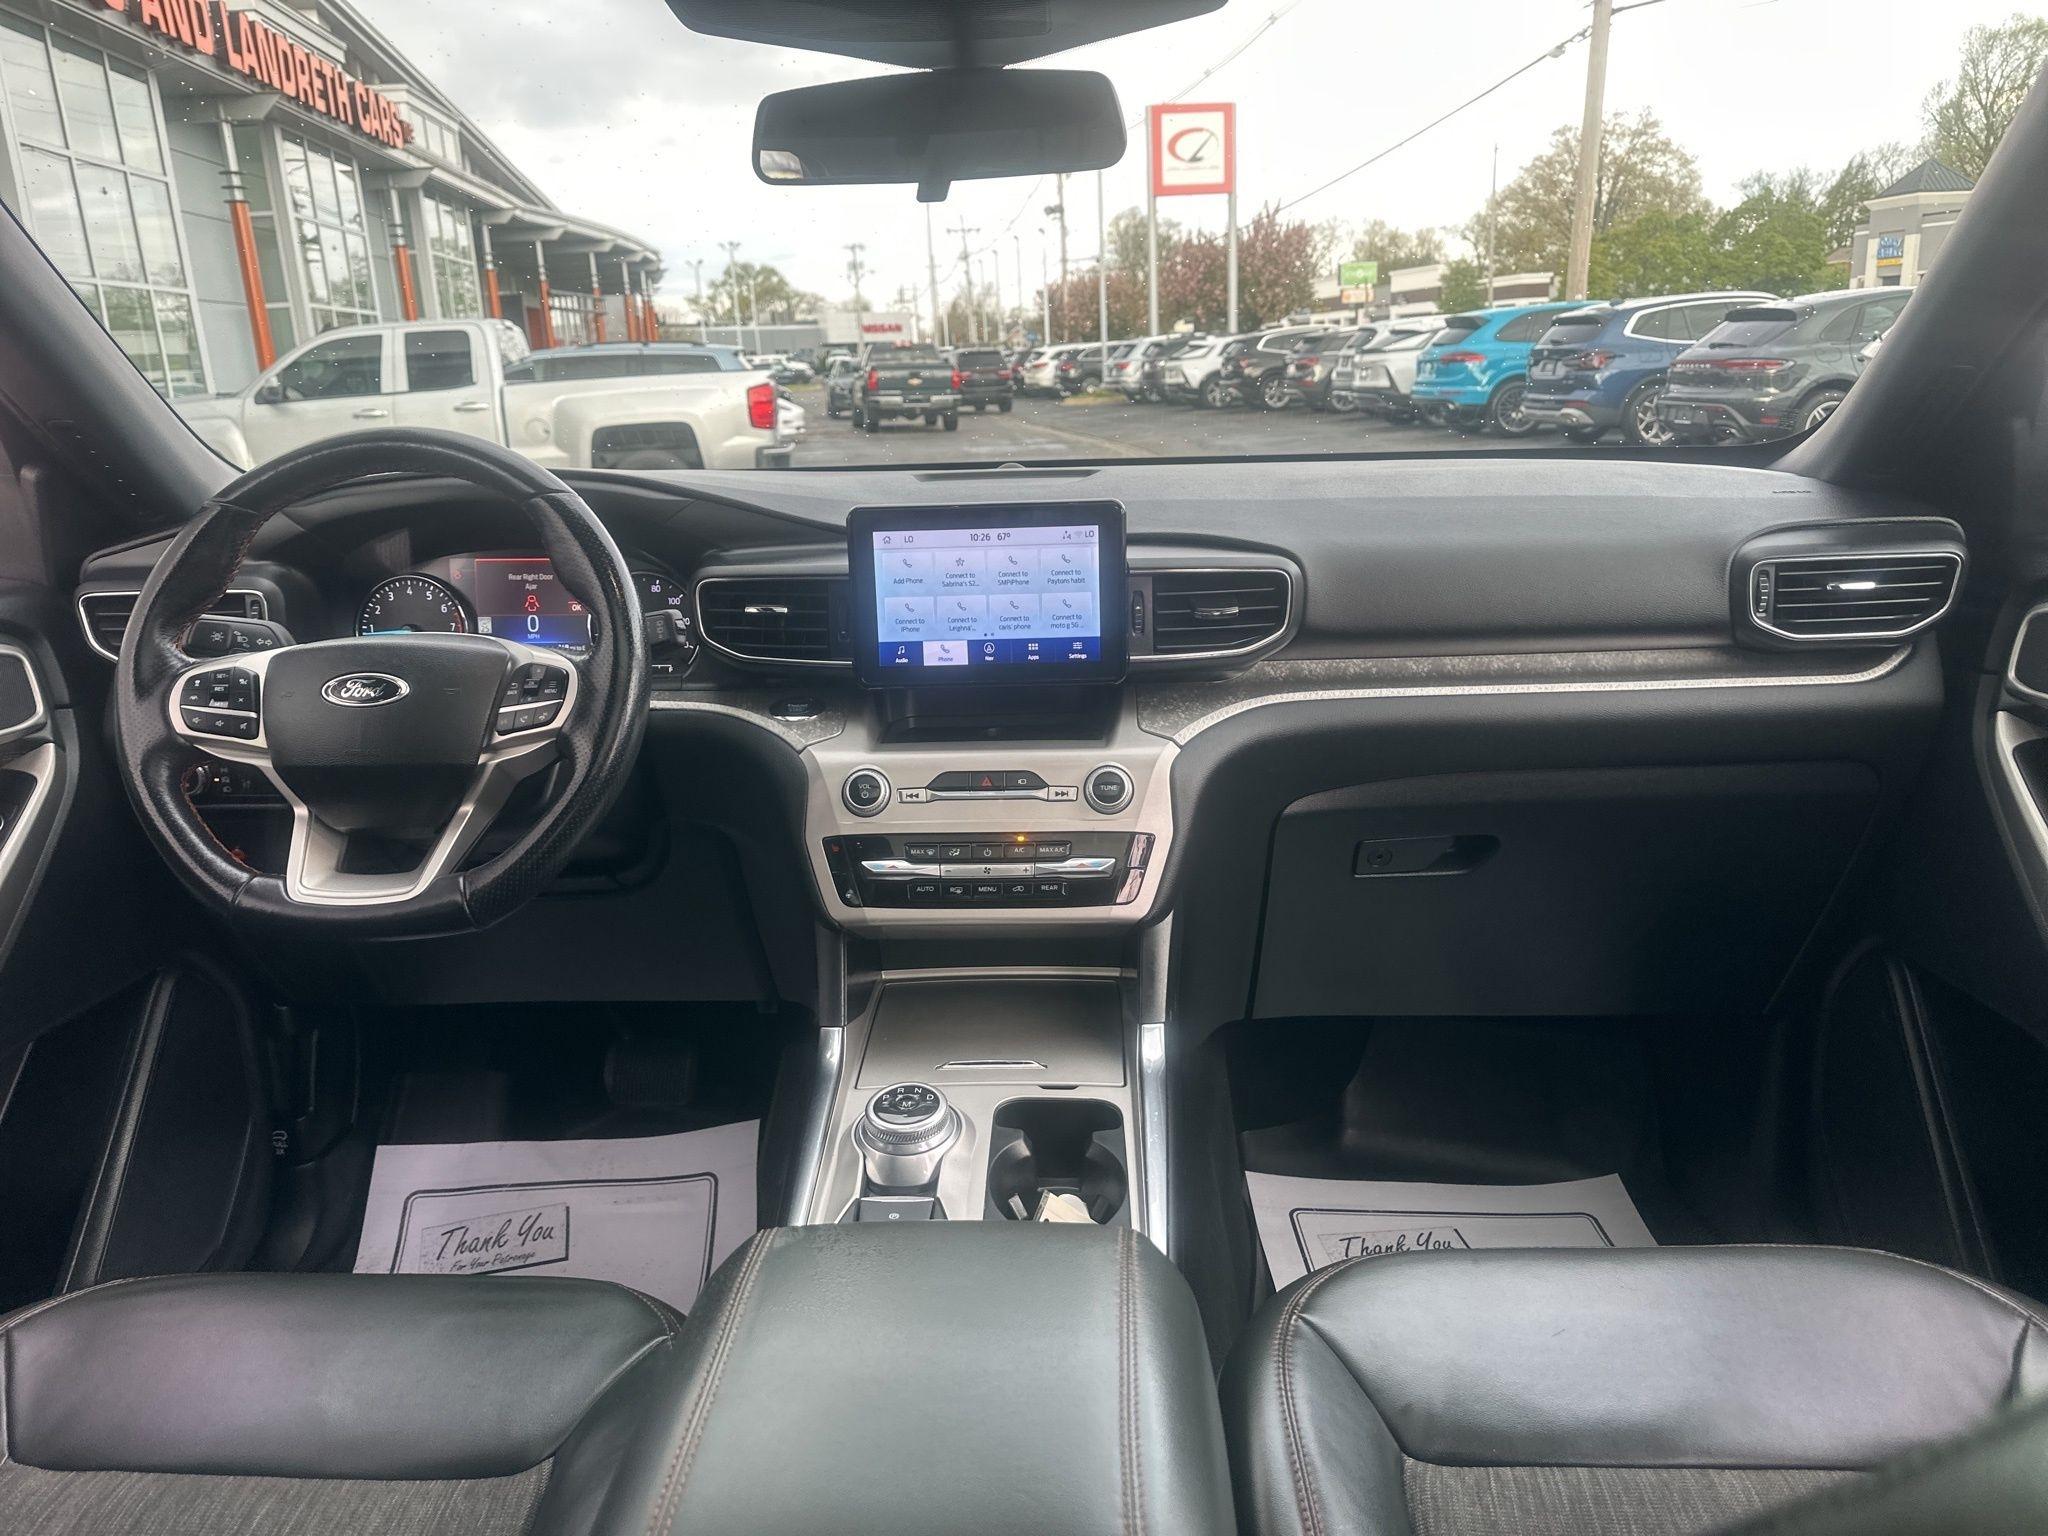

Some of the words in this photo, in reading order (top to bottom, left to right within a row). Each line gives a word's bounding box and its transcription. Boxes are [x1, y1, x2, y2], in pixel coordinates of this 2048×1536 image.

[139, 0, 215, 55] AND
[219, 0, 354, 125] LANDRETH
[353, 80, 405, 149] CARS
[969, 533, 991, 542] 10:26
[1084, 530, 1095, 538] LO
[904, 535, 914, 544] LO
[523, 573, 539, 581] Right
[406, 586, 412, 595] 4
[525, 583, 538, 591] Ajar
[388, 592, 394, 601] 3
[426, 591, 432, 600] 5
[668, 597, 681, 605] 100
[375, 605, 381, 614] 2
[441, 603, 447, 613] 6
[450, 623, 456, 631] 7
[527, 614, 540, 632] 0
[1014, 623, 1032, 631] phone
[340, 679, 387, 698] Ford
[436, 1218, 513, 1261] Thank
[517, 1212, 555, 1247] You
[1338, 1234, 1411, 1258] Thank
[1416, 1231, 1456, 1250] You
[449, 1261, 466, 1272] For
[470, 1258, 490, 1270] Your
